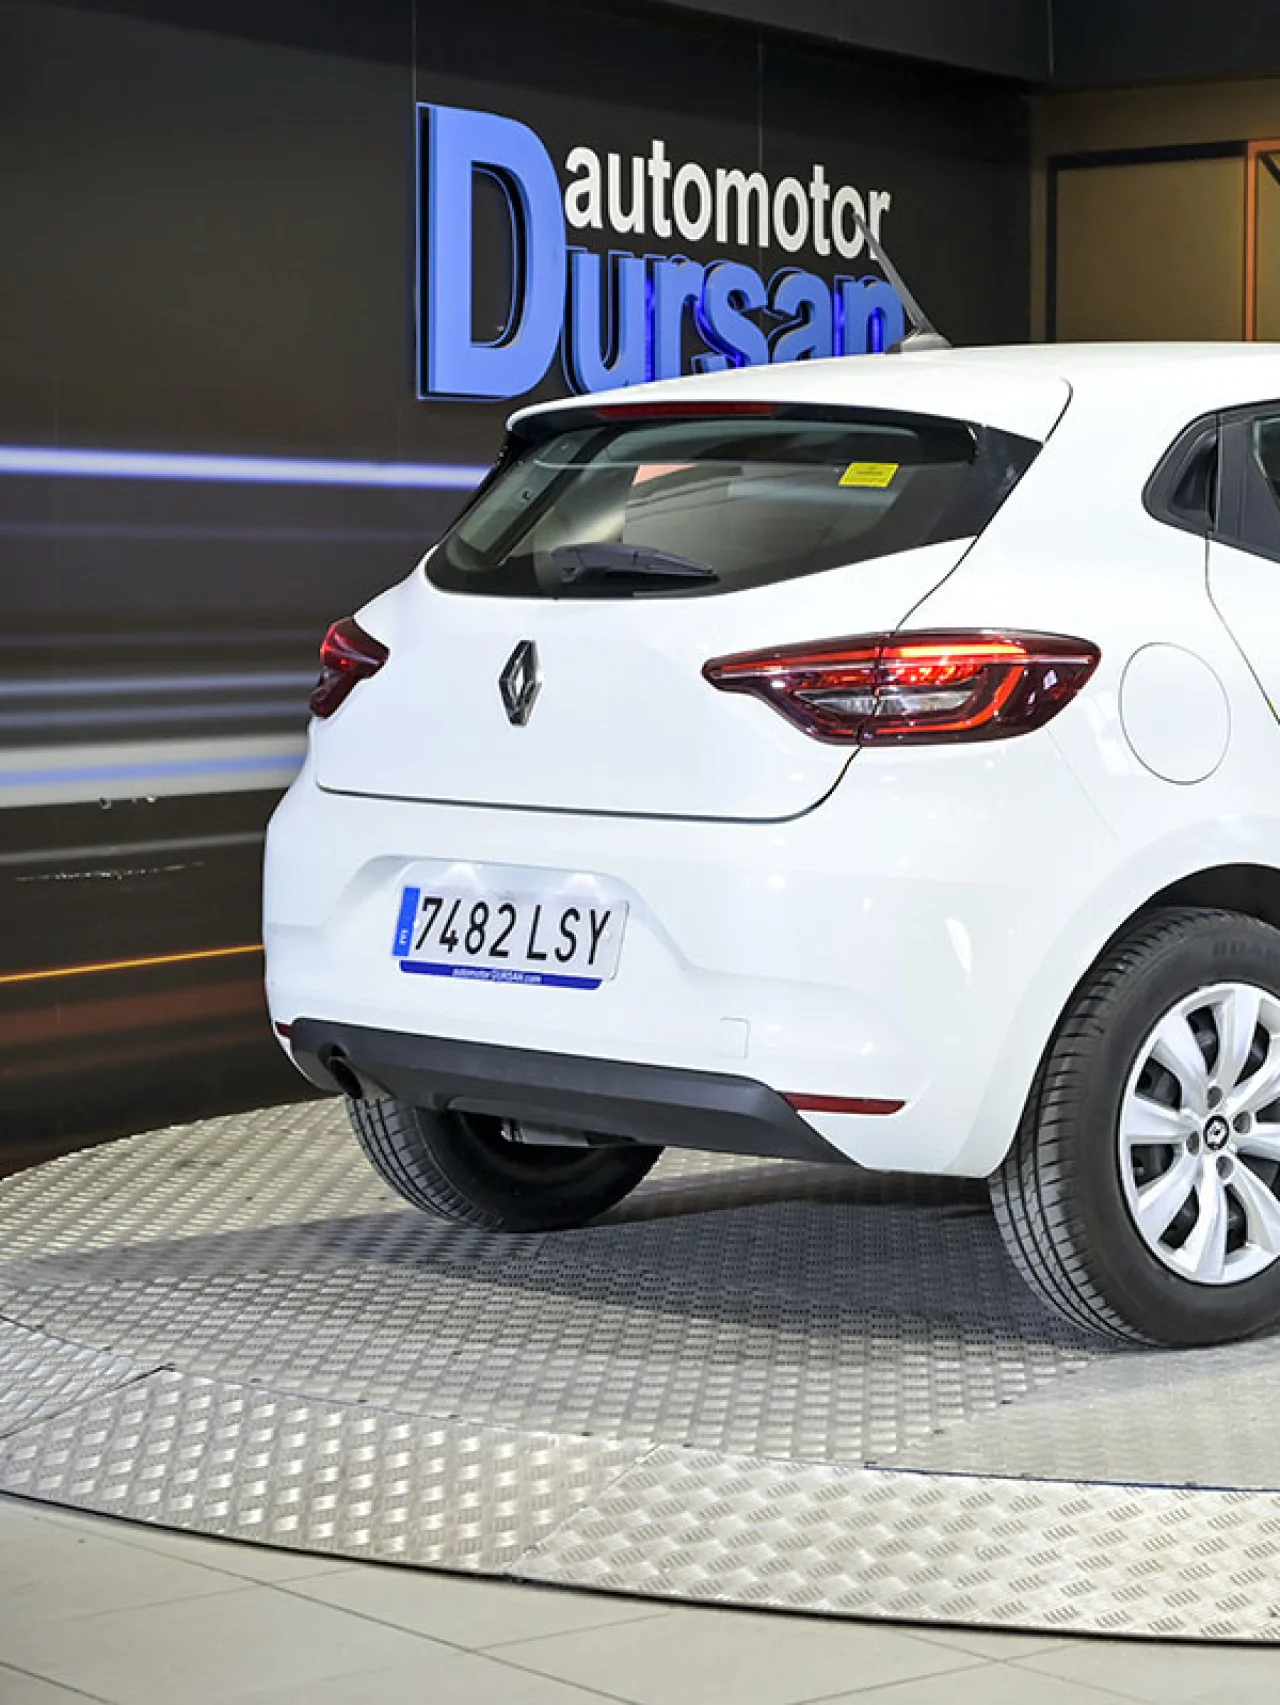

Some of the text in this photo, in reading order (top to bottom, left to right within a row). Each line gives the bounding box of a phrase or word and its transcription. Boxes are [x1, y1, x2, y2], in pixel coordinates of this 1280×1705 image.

[416, 101, 906, 399] Dursan
[564, 139, 891, 260] automotor
[415, 896, 611, 965] 7482 LSY
